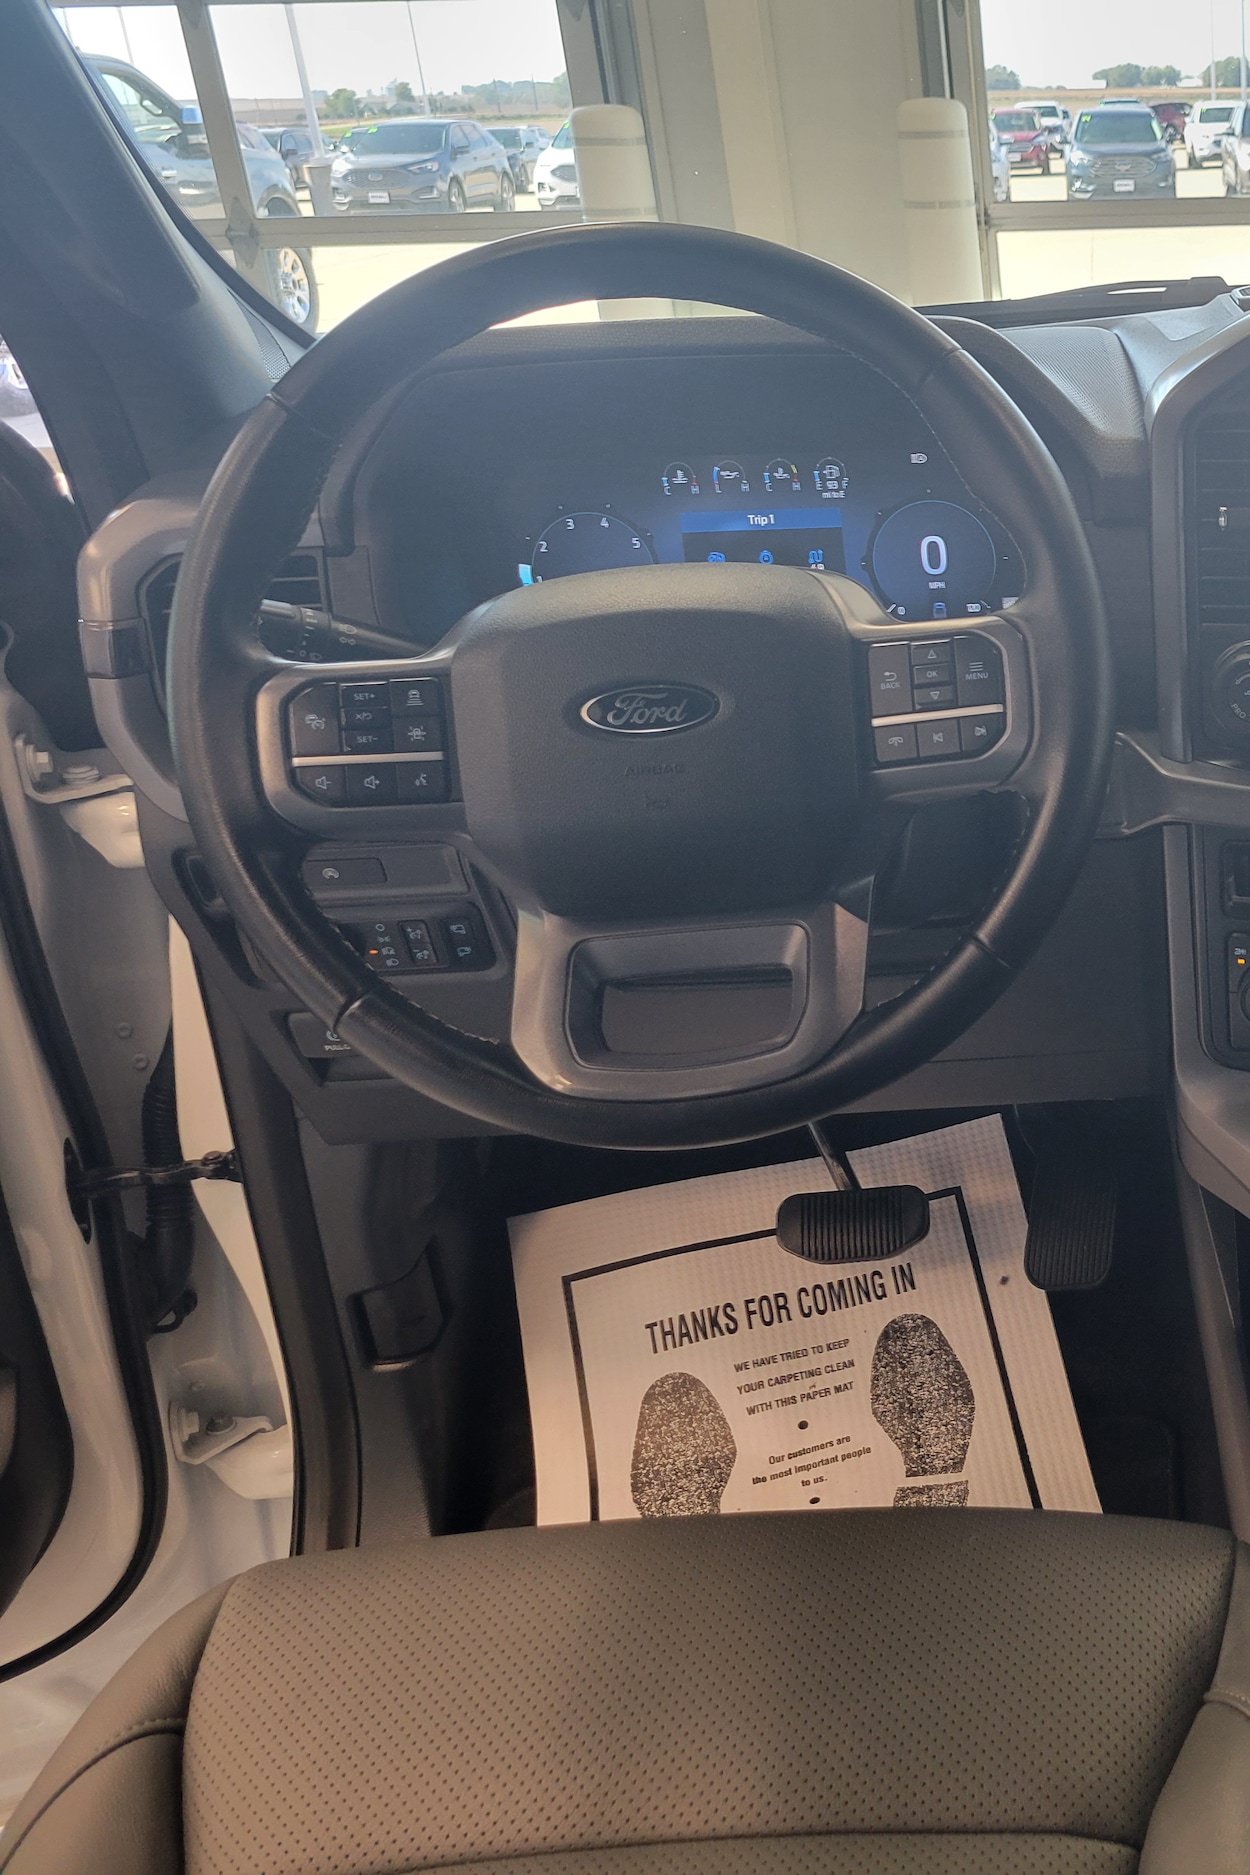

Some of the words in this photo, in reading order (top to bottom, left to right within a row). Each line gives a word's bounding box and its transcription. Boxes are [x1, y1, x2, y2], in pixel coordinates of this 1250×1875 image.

[566, 519, 575, 530] 3
[600, 517, 609, 528] 4
[747, 514, 767, 526] Trip
[768, 514, 775, 525] 1
[538, 541, 548, 552] 2
[631, 537, 641, 548] 5
[920, 535, 947, 575] 0
[926, 670, 939, 678] OK
[965, 672, 989, 681] MENU
[880, 682, 901, 690] BACK
[353, 692, 376, 701] SET+
[607, 692, 689, 726] Ford
[1231, 703, 1247, 719] PRO
[645, 1302, 739, 1354] THANKS
[744, 1291, 793, 1330] FOR
[796, 1269, 888, 1318] COMING
[891, 1262, 917, 1295] IN
[734, 1360, 750, 1373] WE
[752, 1354, 778, 1369] HAVE
[780, 1348, 809, 1362] TRIED
[811, 1344, 824, 1355] TO
[826, 1338, 850, 1352] KEEP
[737, 1380, 765, 1395] YOUR
[768, 1367, 822, 1388] CARPETING
[824, 1359, 855, 1374] CLEAN
[746, 1401, 772, 1416] WITH
[775, 1395, 798, 1409] THIS
[800, 1387, 832, 1403] PAPER
[834, 1381, 854, 1394] MAT
[768, 1454, 785, 1465] Our
[787, 1439, 834, 1460] customers
[836, 1435, 851, 1446] are
[752, 1475, 768, 1485] the
[770, 1467, 792, 1481] most
[794, 1454, 839, 1472] important
[841, 1446, 872, 1462] people
[801, 1478, 811, 1487] to
[813, 1475, 828, 1485] us.
